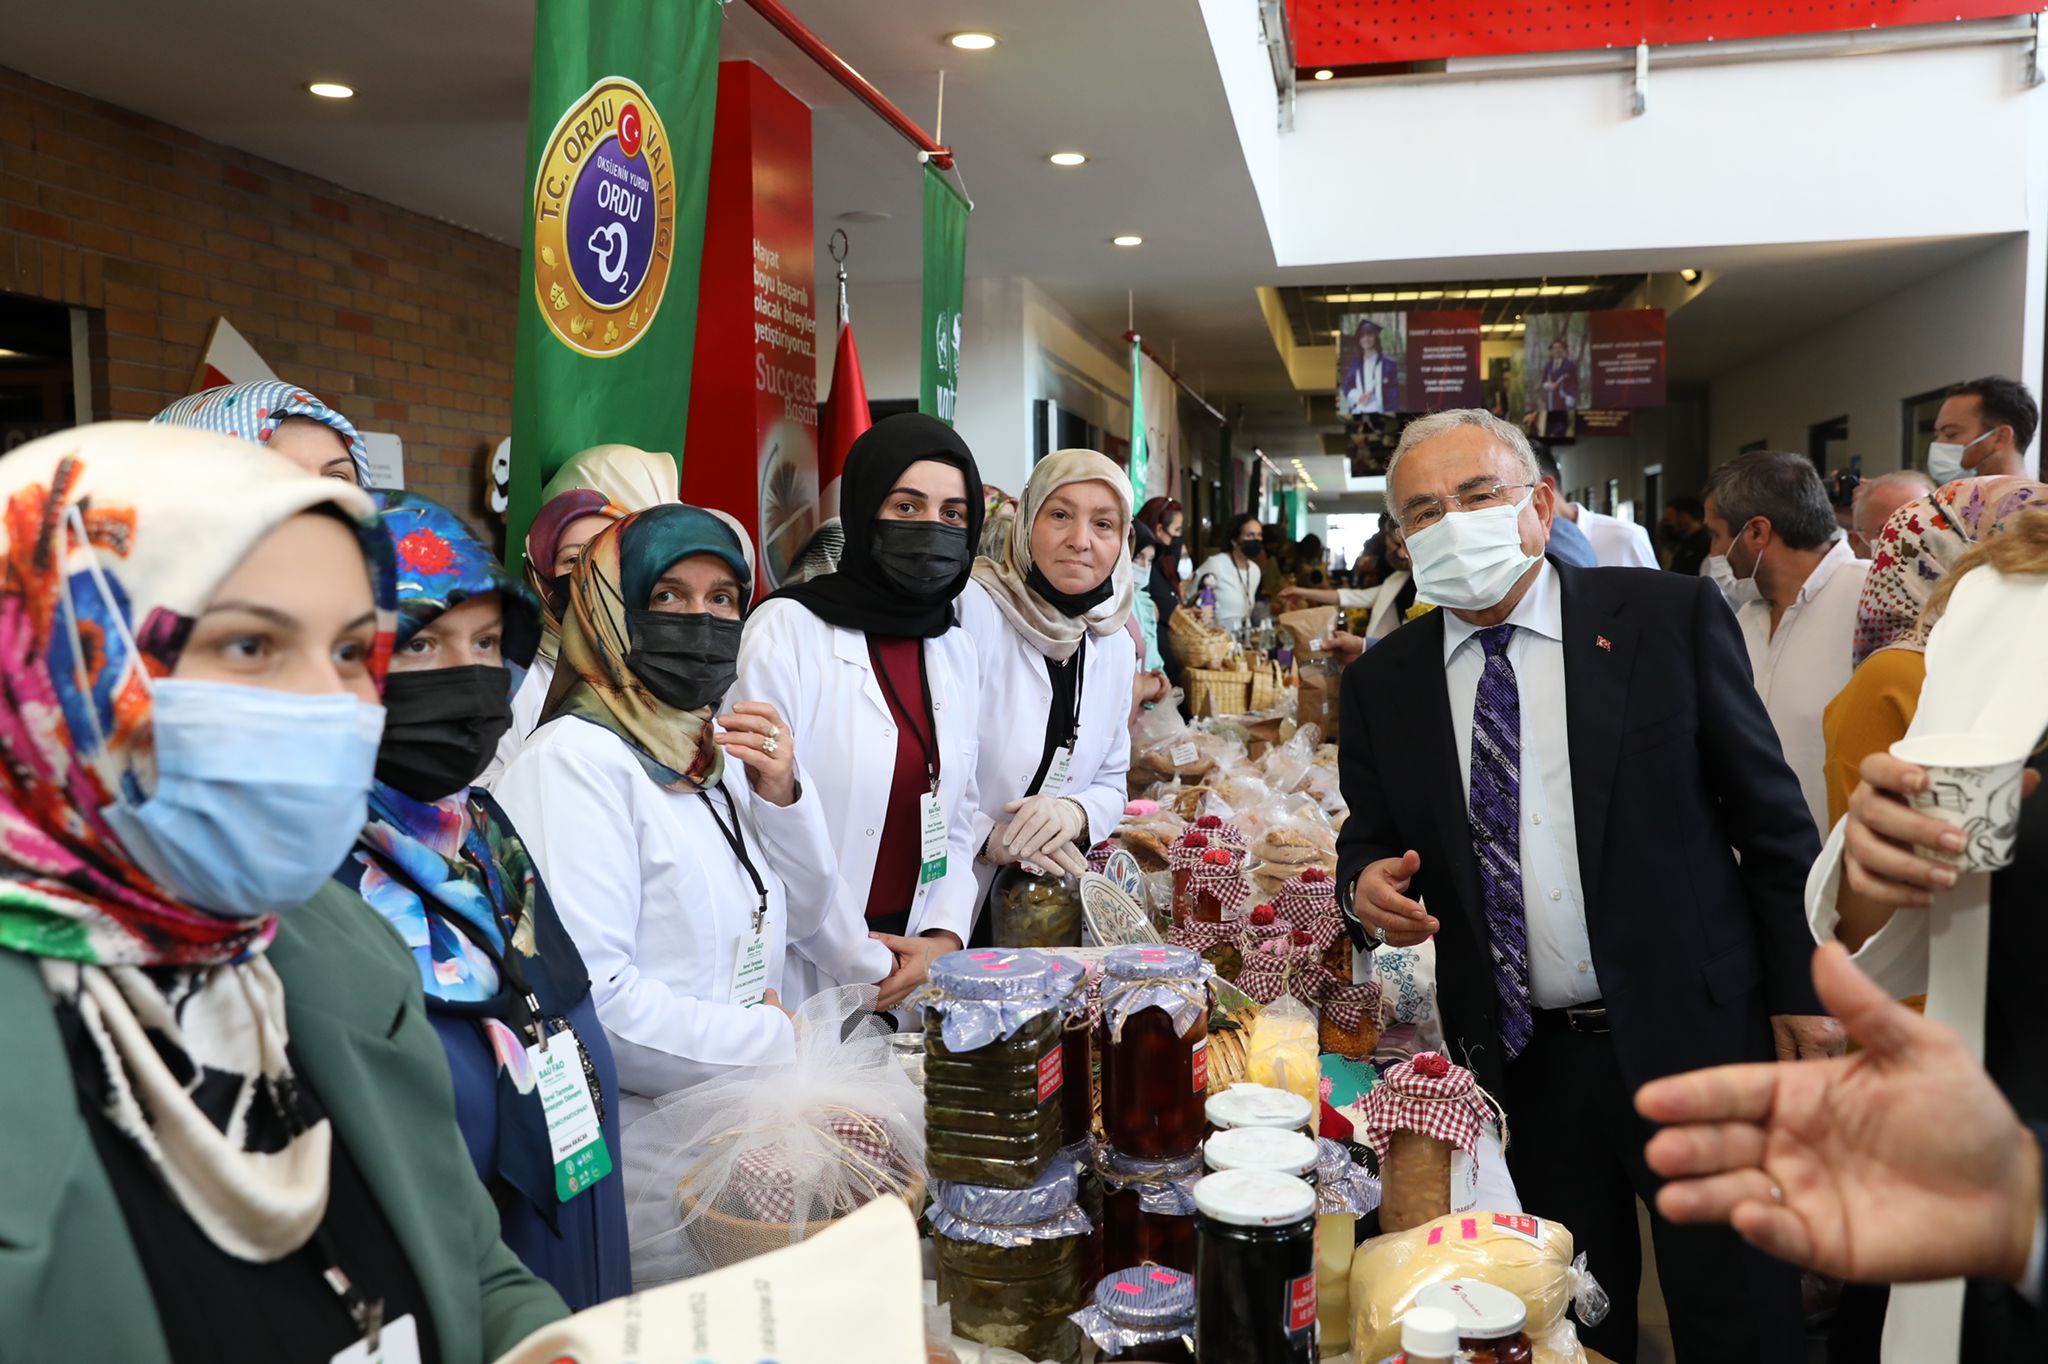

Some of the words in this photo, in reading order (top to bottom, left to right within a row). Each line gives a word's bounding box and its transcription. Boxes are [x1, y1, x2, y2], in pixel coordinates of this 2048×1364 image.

[540, 173, 570, 223] T.C.
[562, 98, 614, 166] ORDU
[596, 155, 628, 182] OKSİJENİN
[629, 170, 650, 194] YURDU
[597, 180, 642, 223] ORDU
[753, 238, 779, 269] Hayat
[753, 264, 775, 293] boyu
[754, 294, 782, 321] olacak
[755, 352, 817, 405] Success
